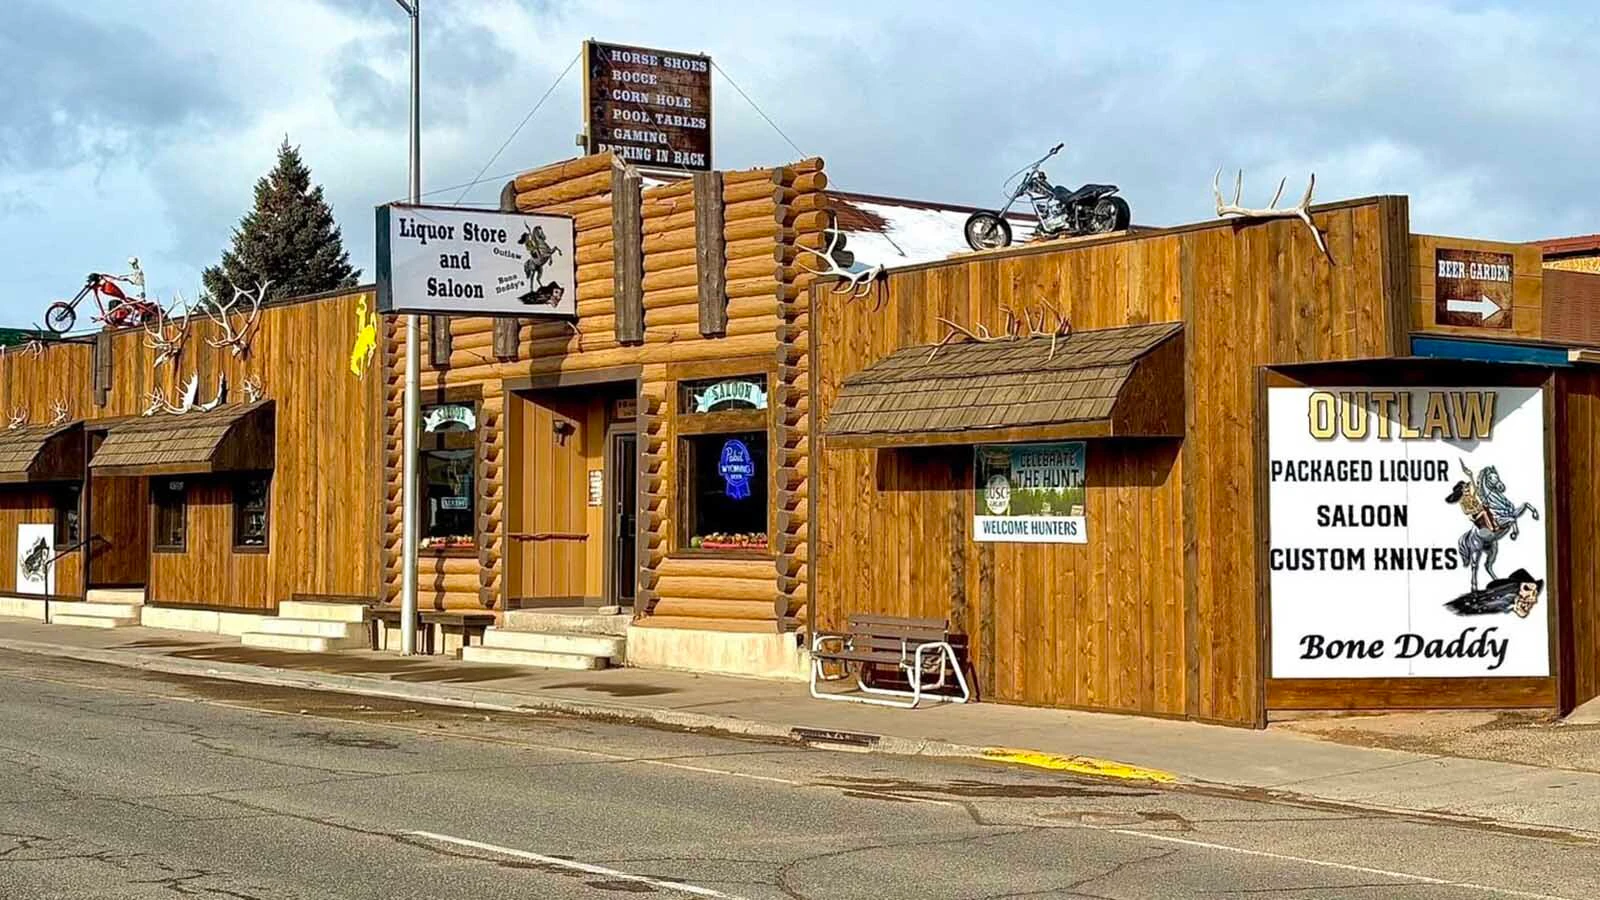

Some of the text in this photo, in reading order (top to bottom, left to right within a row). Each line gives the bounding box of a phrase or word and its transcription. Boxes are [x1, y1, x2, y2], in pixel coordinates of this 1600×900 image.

[611, 50, 707, 72] HORSE SHOES
[612, 70, 657, 85] BOCCE
[612, 89, 692, 108] CORN HOLE
[612, 109, 706, 129] POOL TABLES
[614, 128, 668, 144] GAMING
[656, 150, 669, 163] IN
[674, 151, 705, 166] BACK
[399, 218, 507, 245] Liquor Store
[439, 251, 471, 270] and
[493, 247, 522, 260] Outlaw
[1438, 260, 1510, 282] BEER GARDEN
[427, 277, 484, 299] Saloon
[711, 383, 753, 401] SALOON
[1308, 391, 1498, 442] OUTLAW
[1021, 452, 1076, 468] CELEBRATE
[1016, 468, 1079, 488] THE HUNT
[1271, 459, 1449, 482] PACKAGED LIQUOR
[1317, 504, 1408, 528] SALOON
[983, 520, 1078, 536] WELCOME HUNTERS
[1270, 548, 1459, 571] CUSTOM KNIVES
[1299, 626, 1509, 671] Bone Daddy
